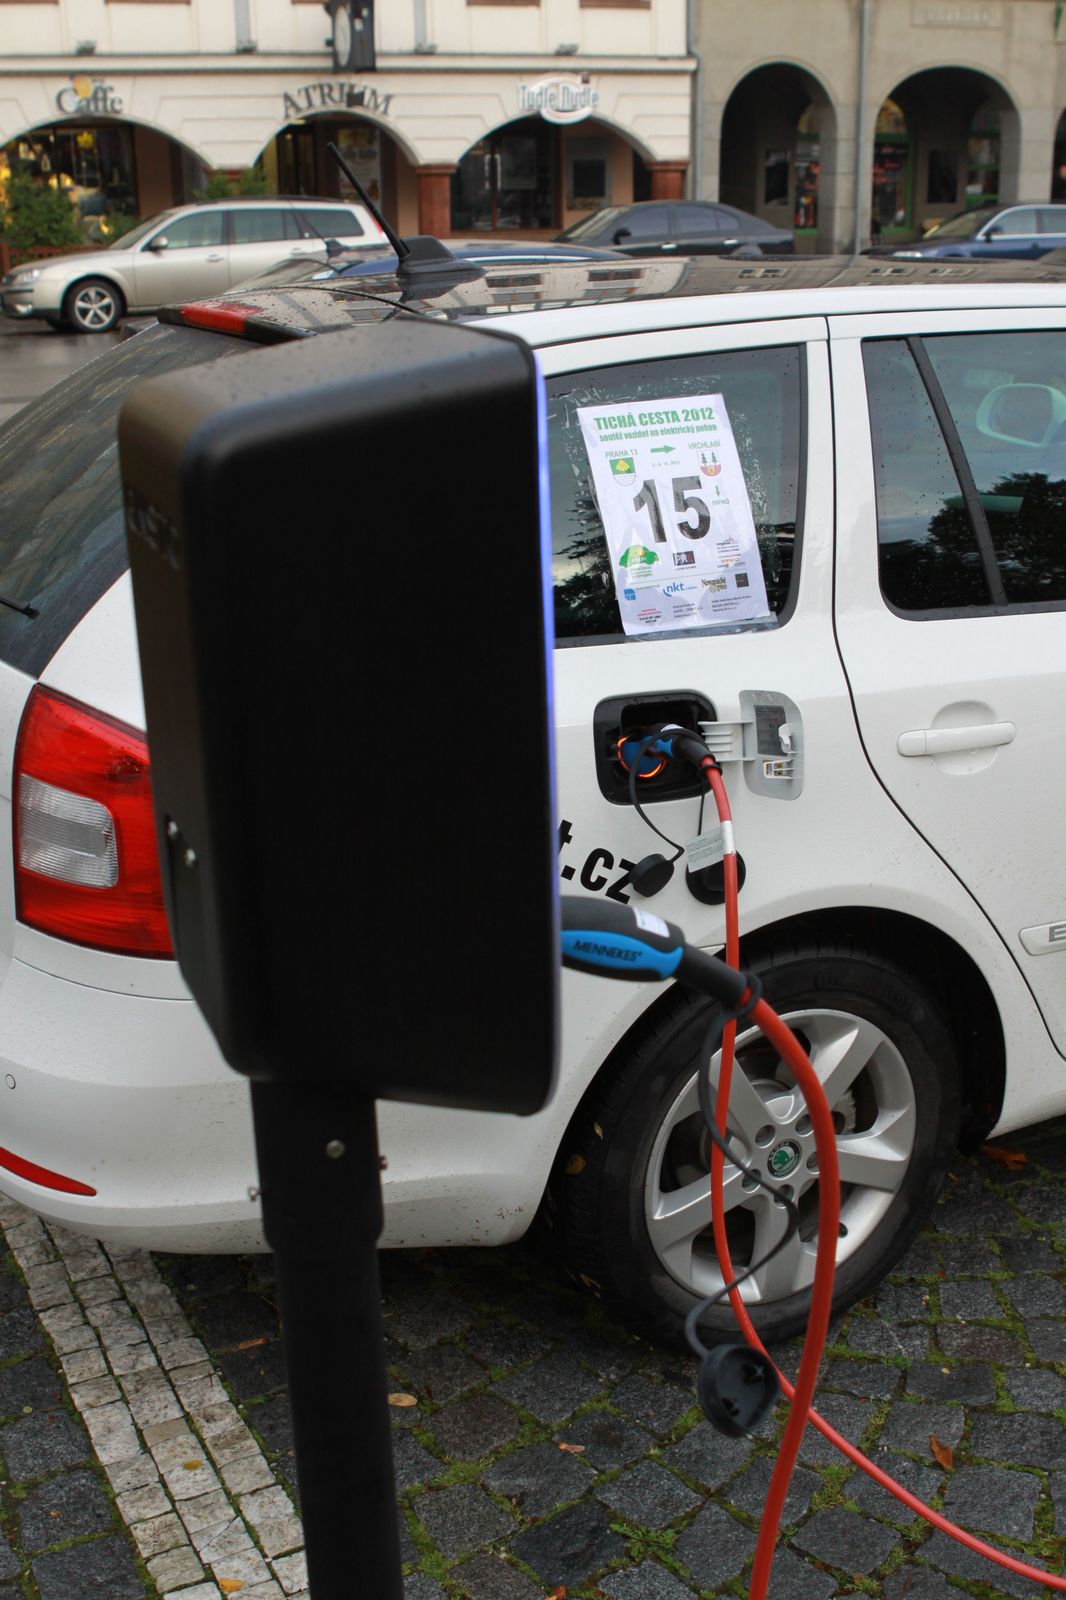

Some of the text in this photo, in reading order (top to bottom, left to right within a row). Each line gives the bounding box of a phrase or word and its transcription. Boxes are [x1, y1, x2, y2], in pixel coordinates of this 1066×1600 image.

[594, 407, 715, 431] TICHÁ CESTA 2012
[605, 450, 629, 459] PRAHA
[633, 476, 711, 543] 15
[667, 582, 685, 593] nkt
[574, 939, 638, 962] MENNEKES
